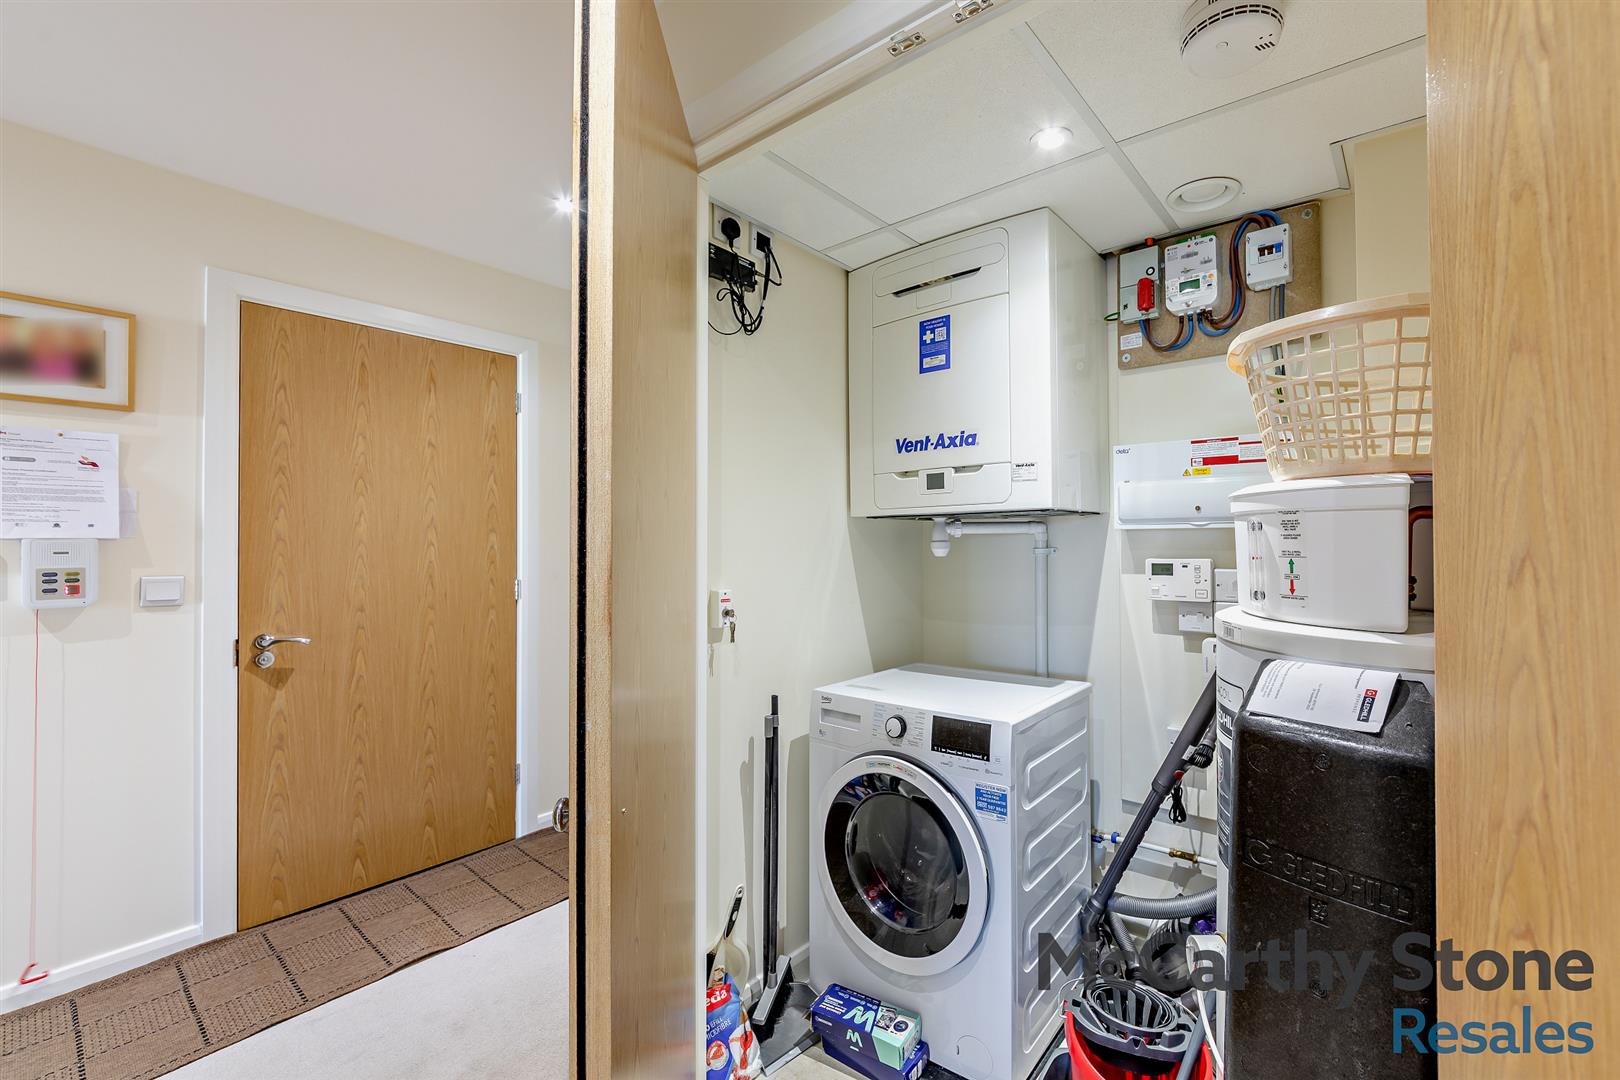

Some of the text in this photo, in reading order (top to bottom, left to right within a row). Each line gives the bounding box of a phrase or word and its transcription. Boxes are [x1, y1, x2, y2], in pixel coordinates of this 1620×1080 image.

[896, 431, 977, 454] Vent-Axia
[1360, 698, 1373, 721] GLEDHILL
[706, 989, 728, 1007] eda
